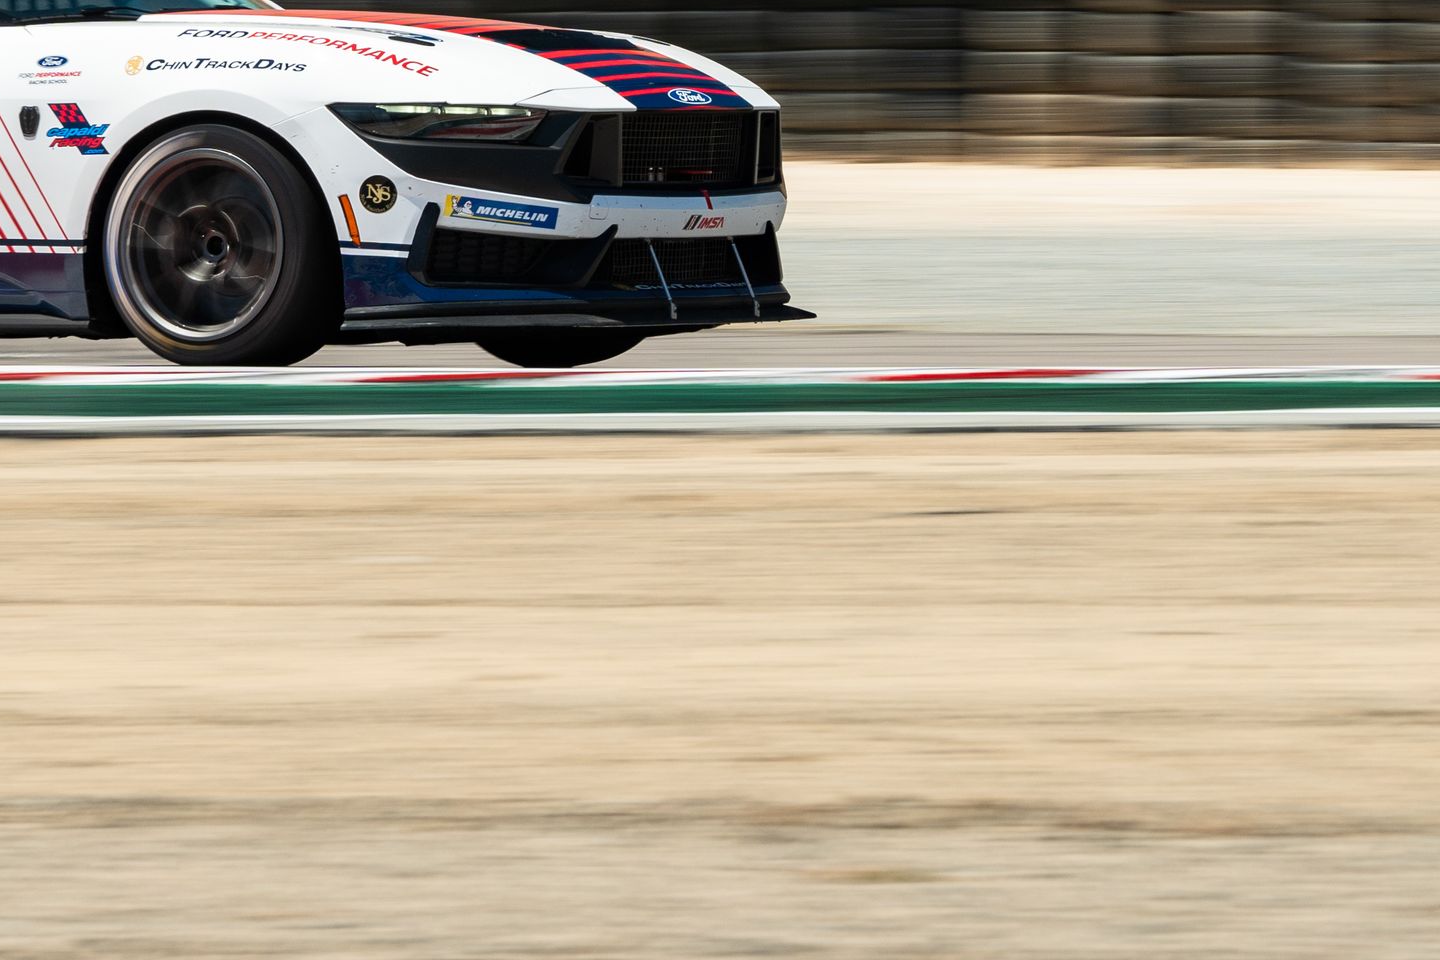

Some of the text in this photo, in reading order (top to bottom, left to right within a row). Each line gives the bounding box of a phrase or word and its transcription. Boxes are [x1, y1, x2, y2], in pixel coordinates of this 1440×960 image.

[675, 90, 706, 103] Ford
[49, 136, 105, 148] racing
[475, 205, 549, 222] MICHELIN
